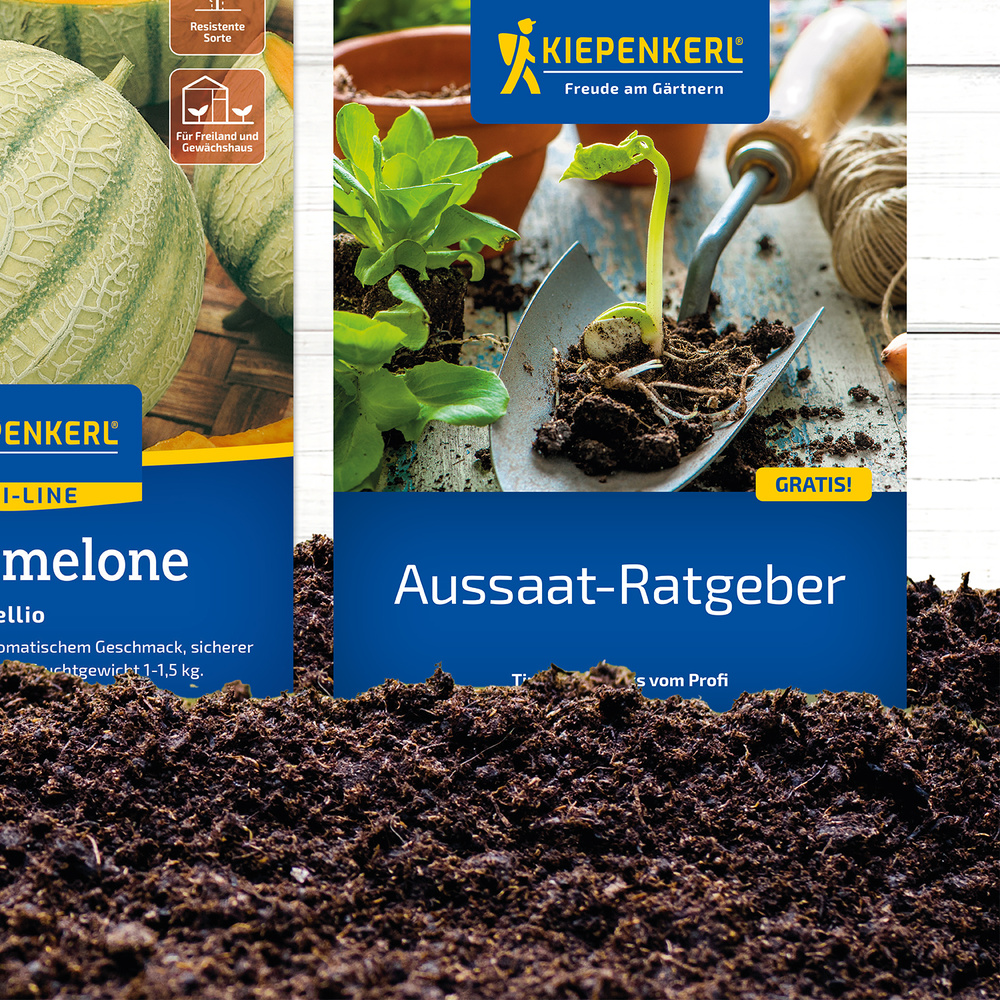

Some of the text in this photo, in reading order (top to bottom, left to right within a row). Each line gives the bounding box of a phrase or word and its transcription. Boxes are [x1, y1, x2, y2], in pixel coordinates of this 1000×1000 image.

[189, 21, 246, 32] Resistente
[203, 33, 232, 43] Sorte
[564, 82, 724, 95] Freude am Gärtnern
[176, 131, 259, 141] Für Freiland und
[181, 143, 253, 153] Gewächshaus
[775, 476, 852, 493] GRATIS!
[393, 563, 846, 616] Aussaat-Ratgeber
[95, 640, 187, 656] Geschmack,
[190, 640, 254, 654] sicherer
[143, 663, 178, 679] 1-1,5
[182, 663, 204, 680] kg.
[648, 676, 685, 687] vom
[688, 672, 729, 687] Profi
